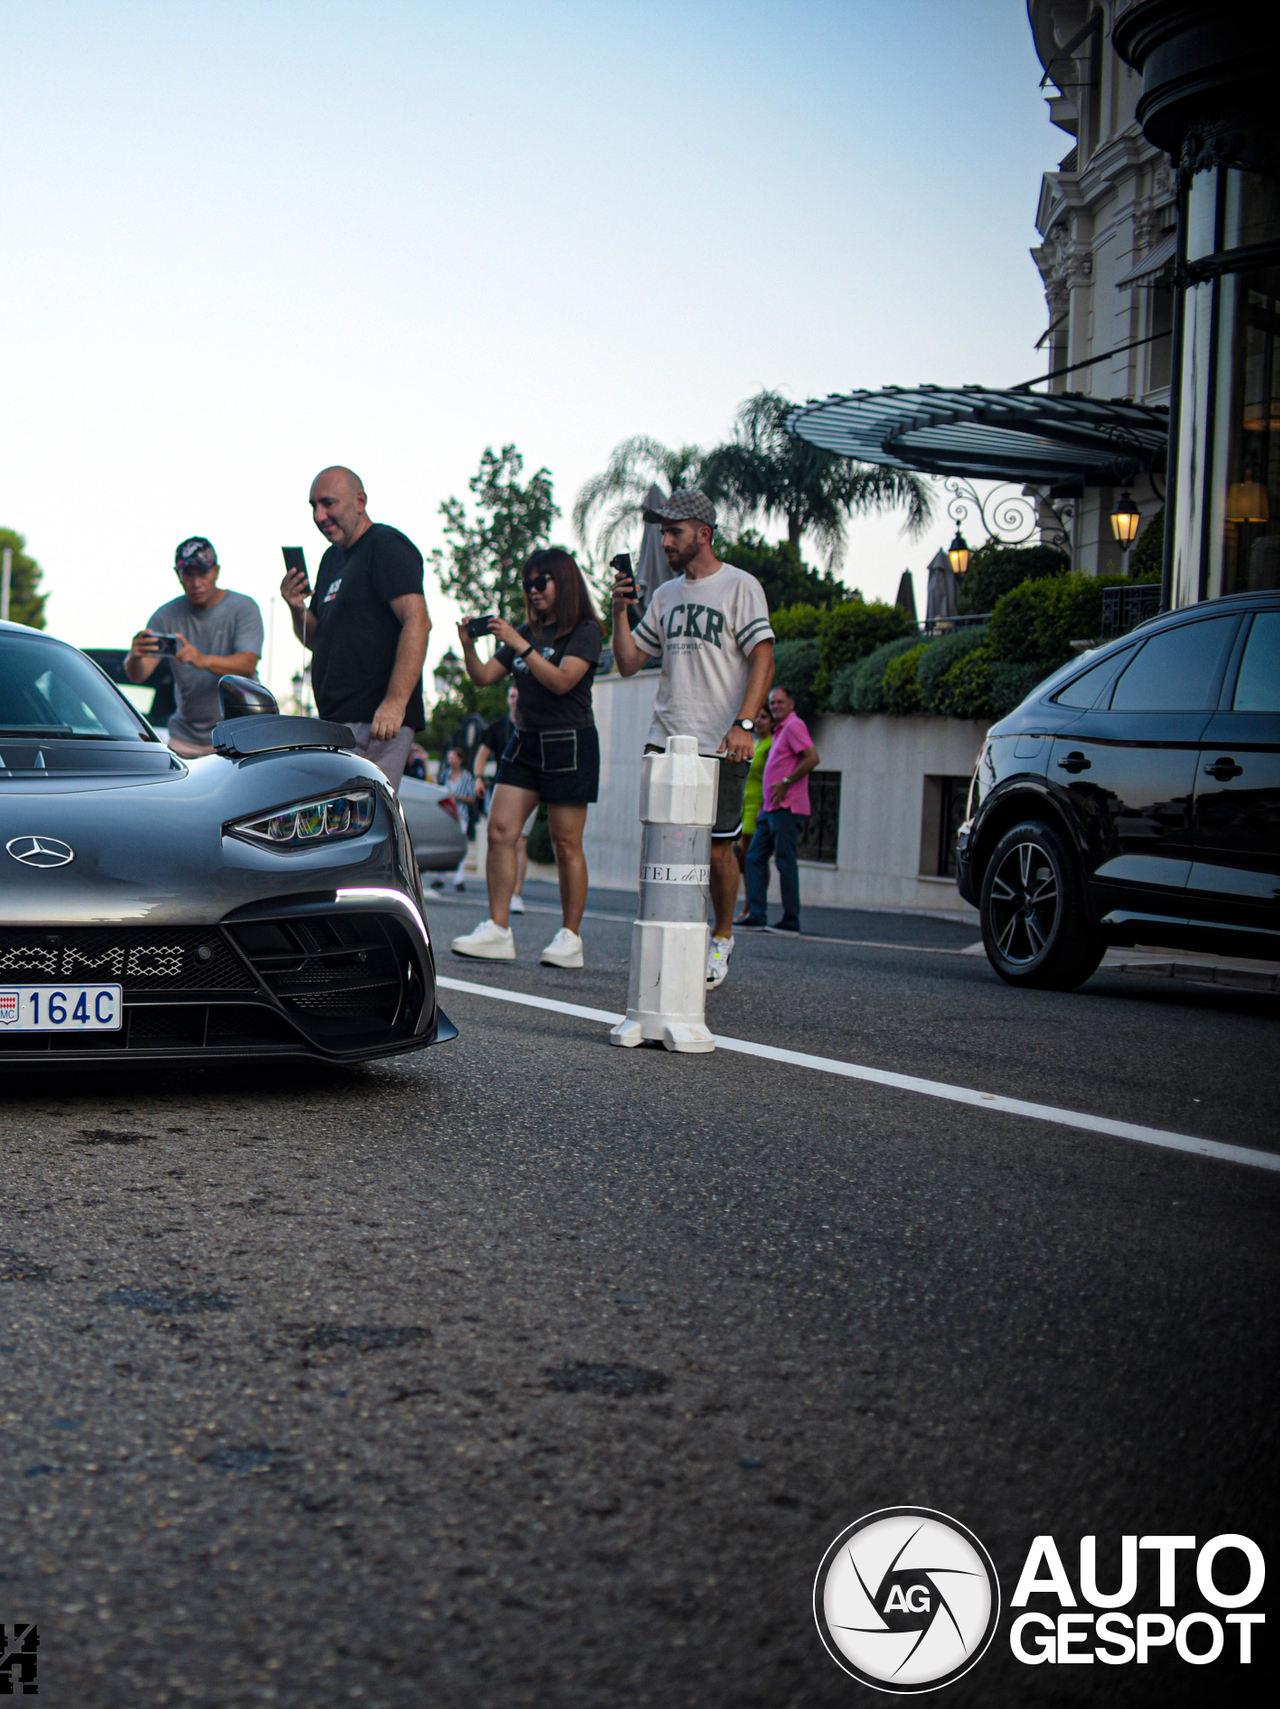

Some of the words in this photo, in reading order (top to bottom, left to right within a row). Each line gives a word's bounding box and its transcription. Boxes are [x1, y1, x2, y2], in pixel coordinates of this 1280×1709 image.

[660, 604, 724, 649] CKR
[681, 869, 695, 881] de
[0, 1010, 15, 1019] MC
[29, 991, 114, 1024] 164C
